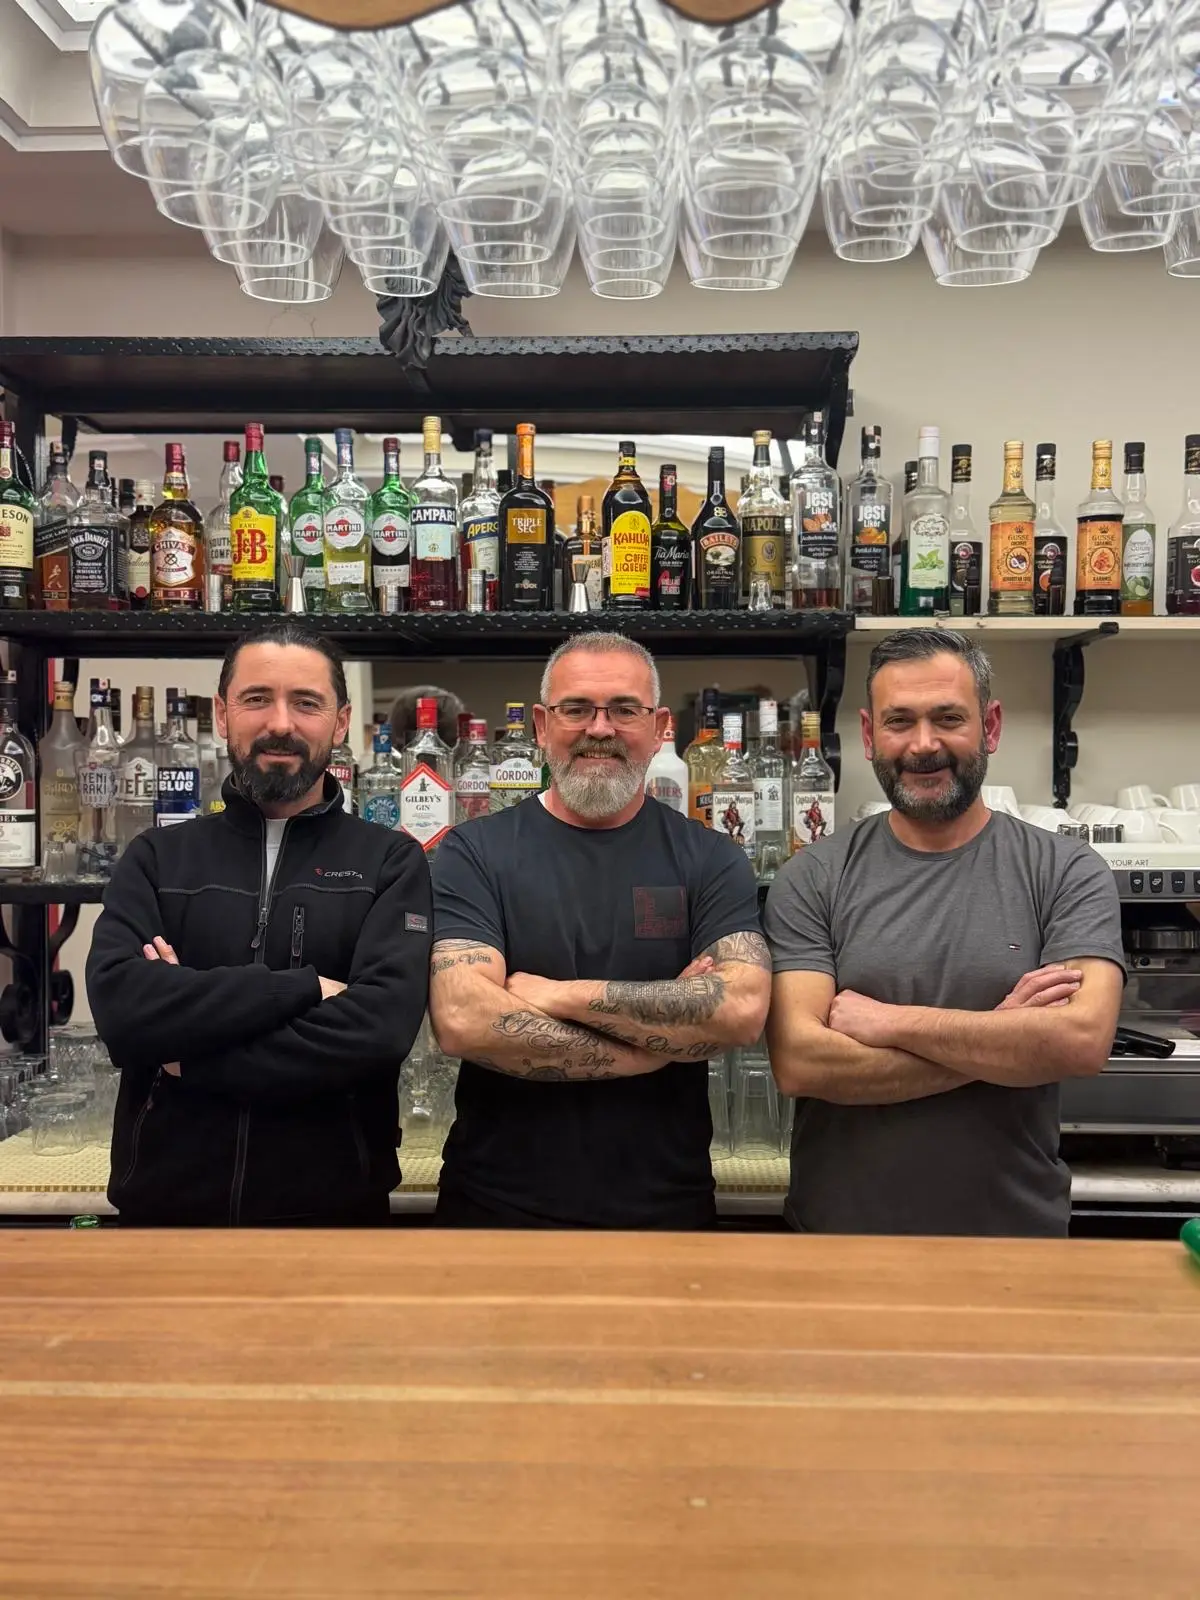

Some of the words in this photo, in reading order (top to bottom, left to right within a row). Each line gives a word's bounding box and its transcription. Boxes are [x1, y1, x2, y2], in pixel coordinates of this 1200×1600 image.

[2, 509, 29, 523] ESON
[411, 508, 456, 522] CAMPARI
[512, 517, 542, 527] TRIPLE
[744, 517, 780, 531] NAPOLE
[327, 524, 360, 532] MARTINI
[517, 525, 536, 534] SEC
[374, 530, 408, 538] MARTINI
[70, 534, 85, 547] JACK
[210, 537, 231, 547] SOUTH
[703, 534, 737, 547] BAILEYS
[154, 541, 189, 552] CHIVAS
[233, 529, 268, 564] J&B
[211, 549, 230, 559] COMF
[653, 545, 667, 560] Tia
[664, 546, 689, 560] Maria
[180, 590, 190, 598] 12
[83, 783, 107, 795] RAKI
[125, 773, 153, 797] EFE
[457, 781, 488, 791] GORDON
[405, 794, 442, 803] GILBEY'S
[715, 795, 733, 804] Captain
[735, 794, 753, 803] Morgan
[795, 795, 816, 805] Captain
[817, 794, 833, 803] Morgan
[1111, 859, 1133, 867] YOUR
[1135, 859, 1149, 867] ART
[324, 870, 363, 880] CRESTA
